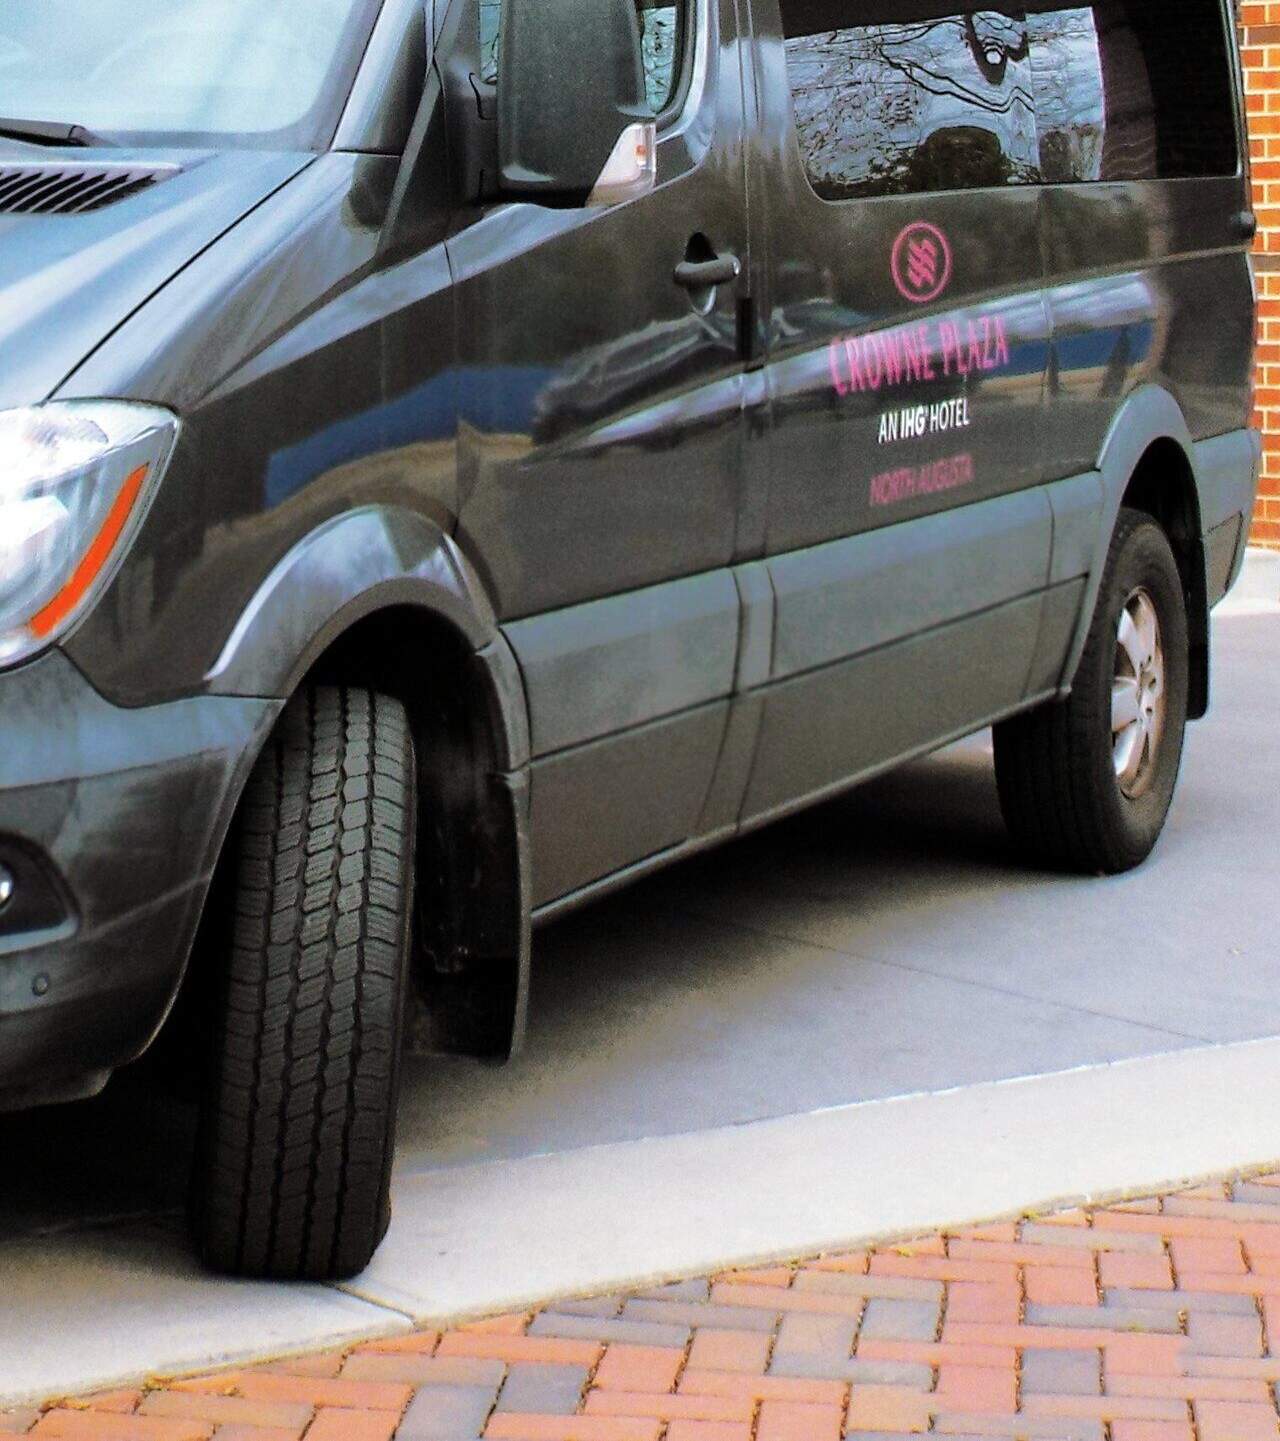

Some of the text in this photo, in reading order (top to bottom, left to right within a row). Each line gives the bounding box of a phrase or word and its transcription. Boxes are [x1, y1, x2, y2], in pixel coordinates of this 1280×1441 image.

[828, 315, 1010, 396] CROWNE PLAZA
[877, 413, 898, 444] AN
[928, 397, 970, 430] HOTEL
